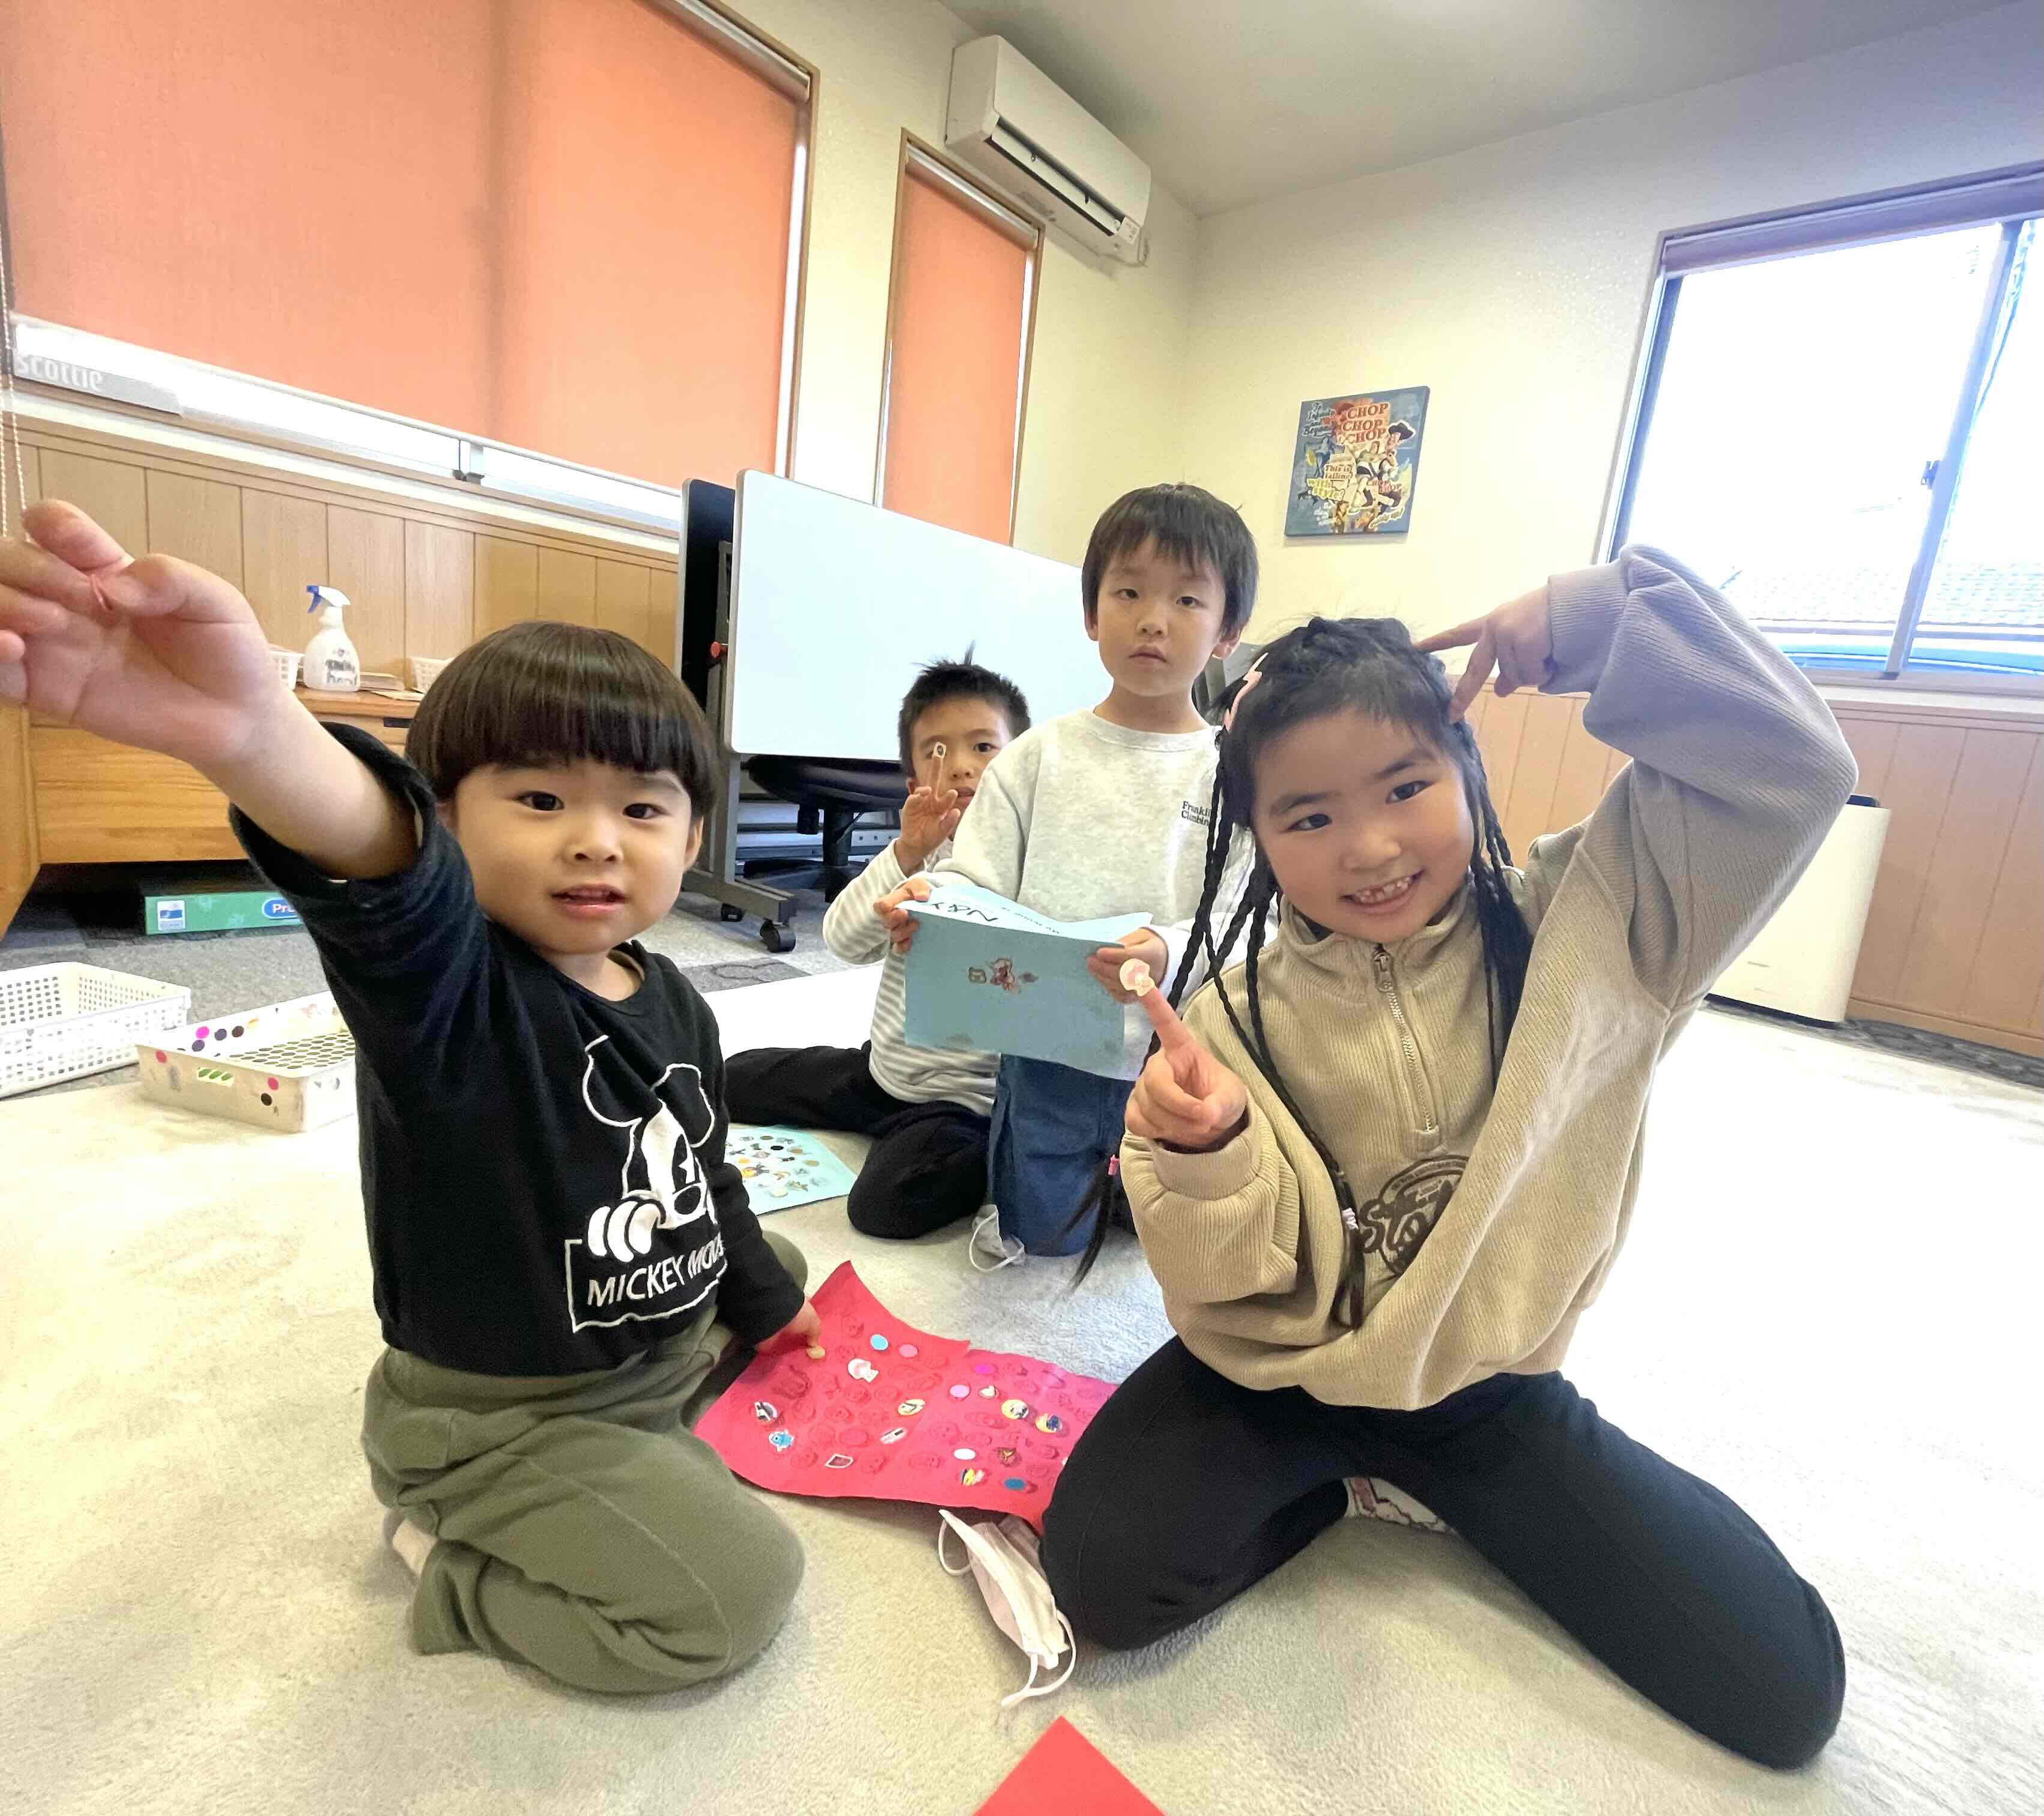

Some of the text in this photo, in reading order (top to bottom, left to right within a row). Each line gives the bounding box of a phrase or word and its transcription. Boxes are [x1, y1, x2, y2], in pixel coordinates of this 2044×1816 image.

[1347, 403, 1389, 419] CHOP
[1342, 419, 1383, 432] CHOP
[273, 903, 297, 913] Pr
[587, 1255, 685, 1307] MICKEY
